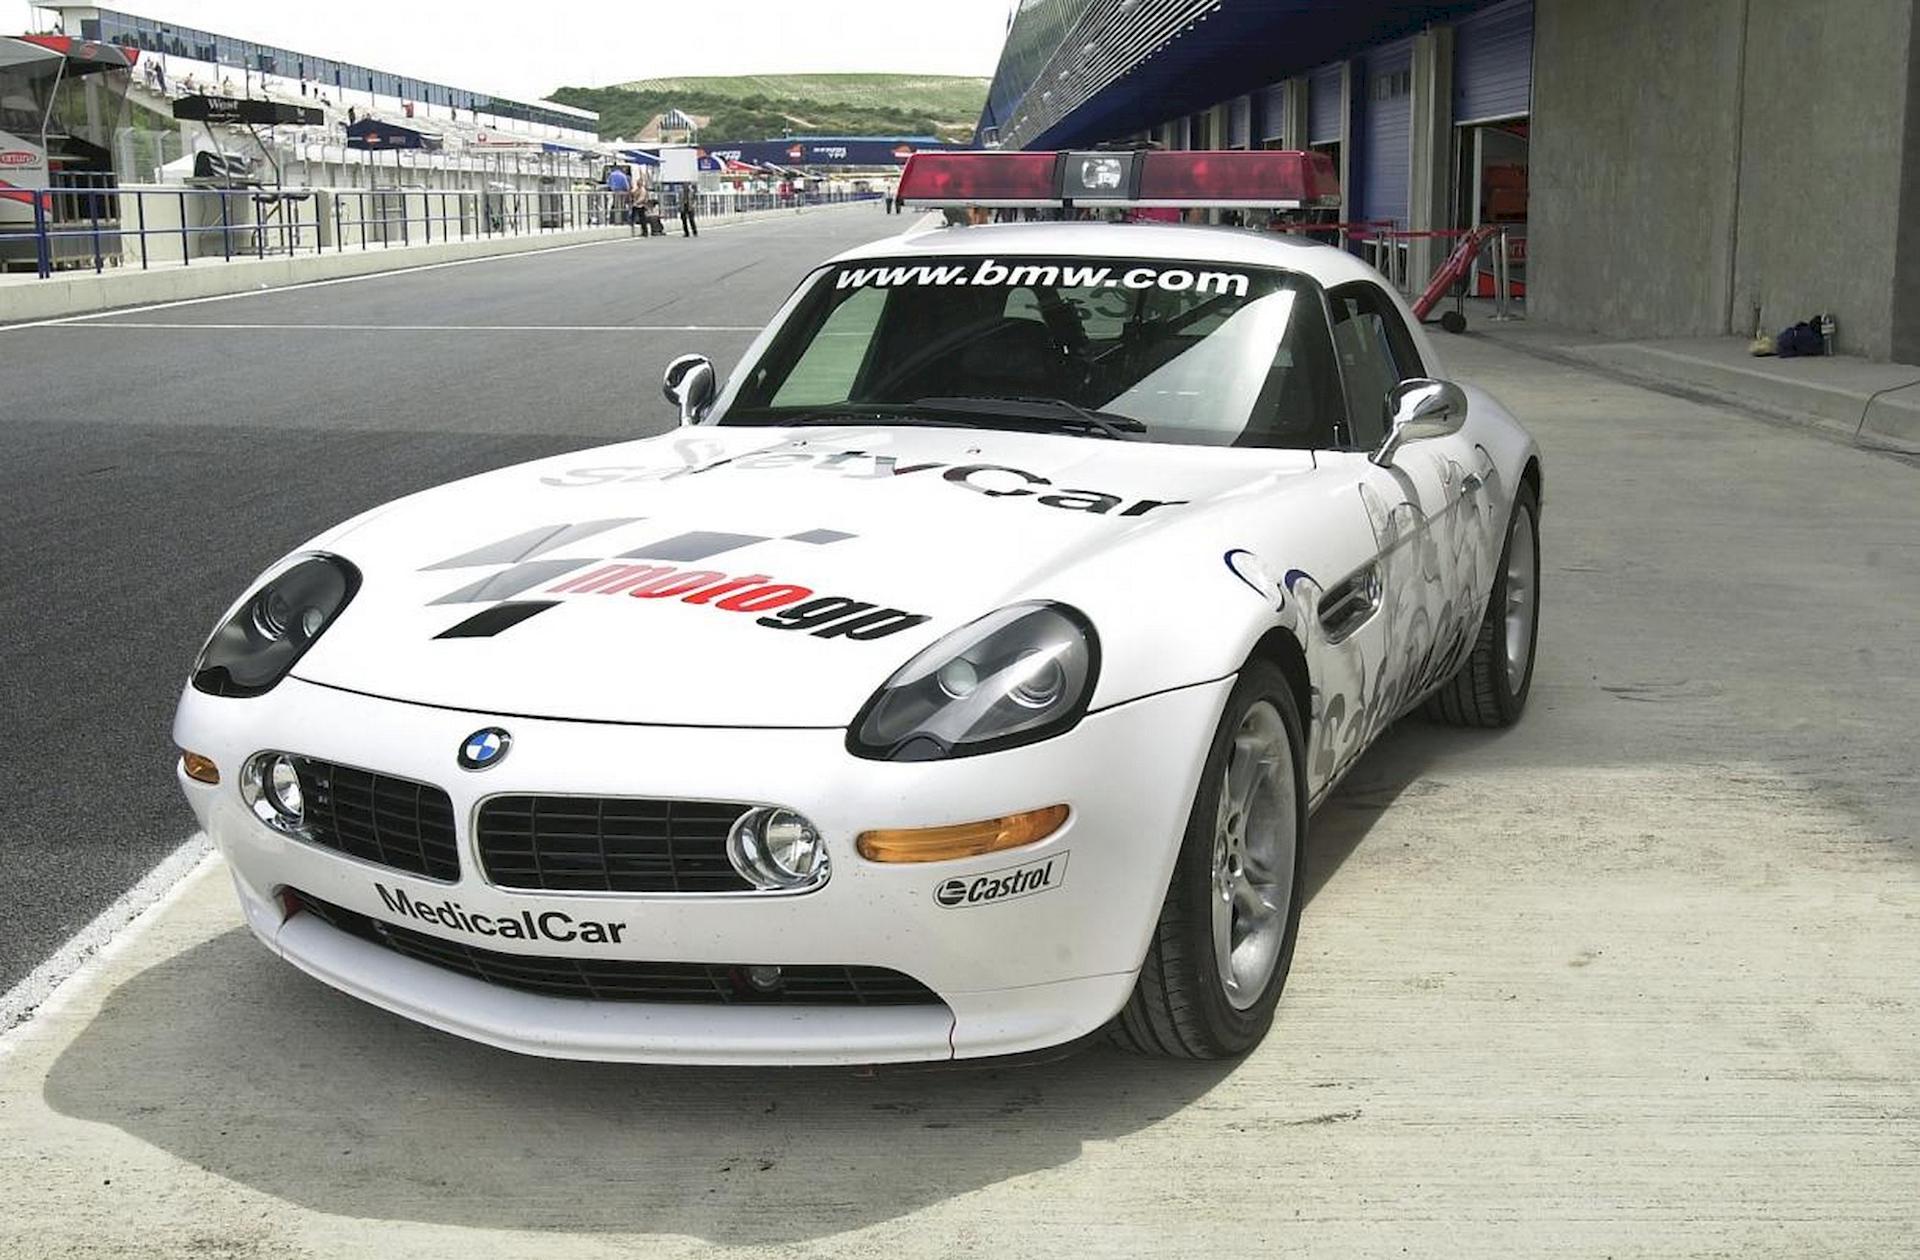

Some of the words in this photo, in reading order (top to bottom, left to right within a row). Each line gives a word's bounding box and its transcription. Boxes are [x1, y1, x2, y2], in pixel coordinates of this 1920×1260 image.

[836, 259, 1250, 297] www.bmw.com
[546, 564, 932, 641] motogp
[967, 861, 1053, 903] Castrol
[374, 882, 627, 944] MedicalCar
